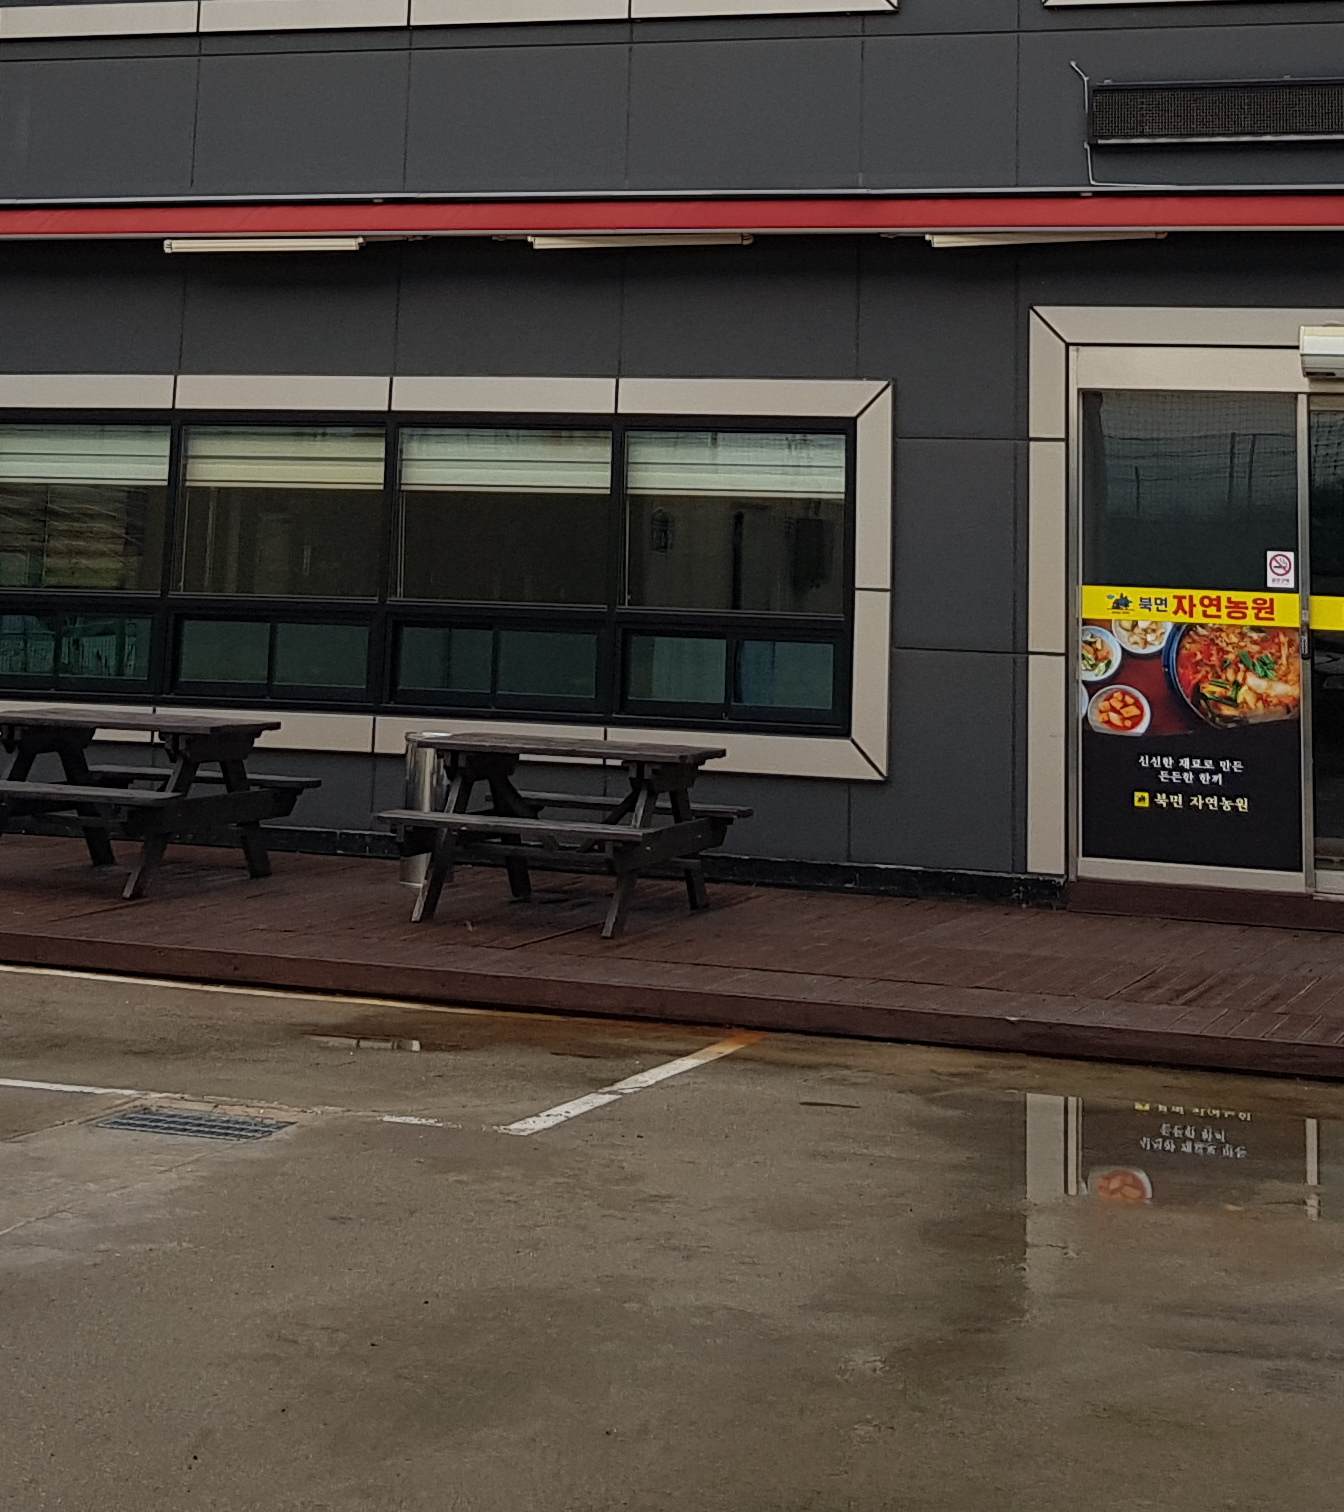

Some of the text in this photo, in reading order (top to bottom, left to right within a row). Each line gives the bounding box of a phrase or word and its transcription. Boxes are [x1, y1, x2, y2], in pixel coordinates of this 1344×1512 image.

[1138, 594, 1276, 621] 북면 자연농원
[1139, 754, 1244, 772] 신선한 재료로 만든
[1158, 770, 1194, 784] 든든한
[1154, 793, 1249, 812] 북면 자연농원
